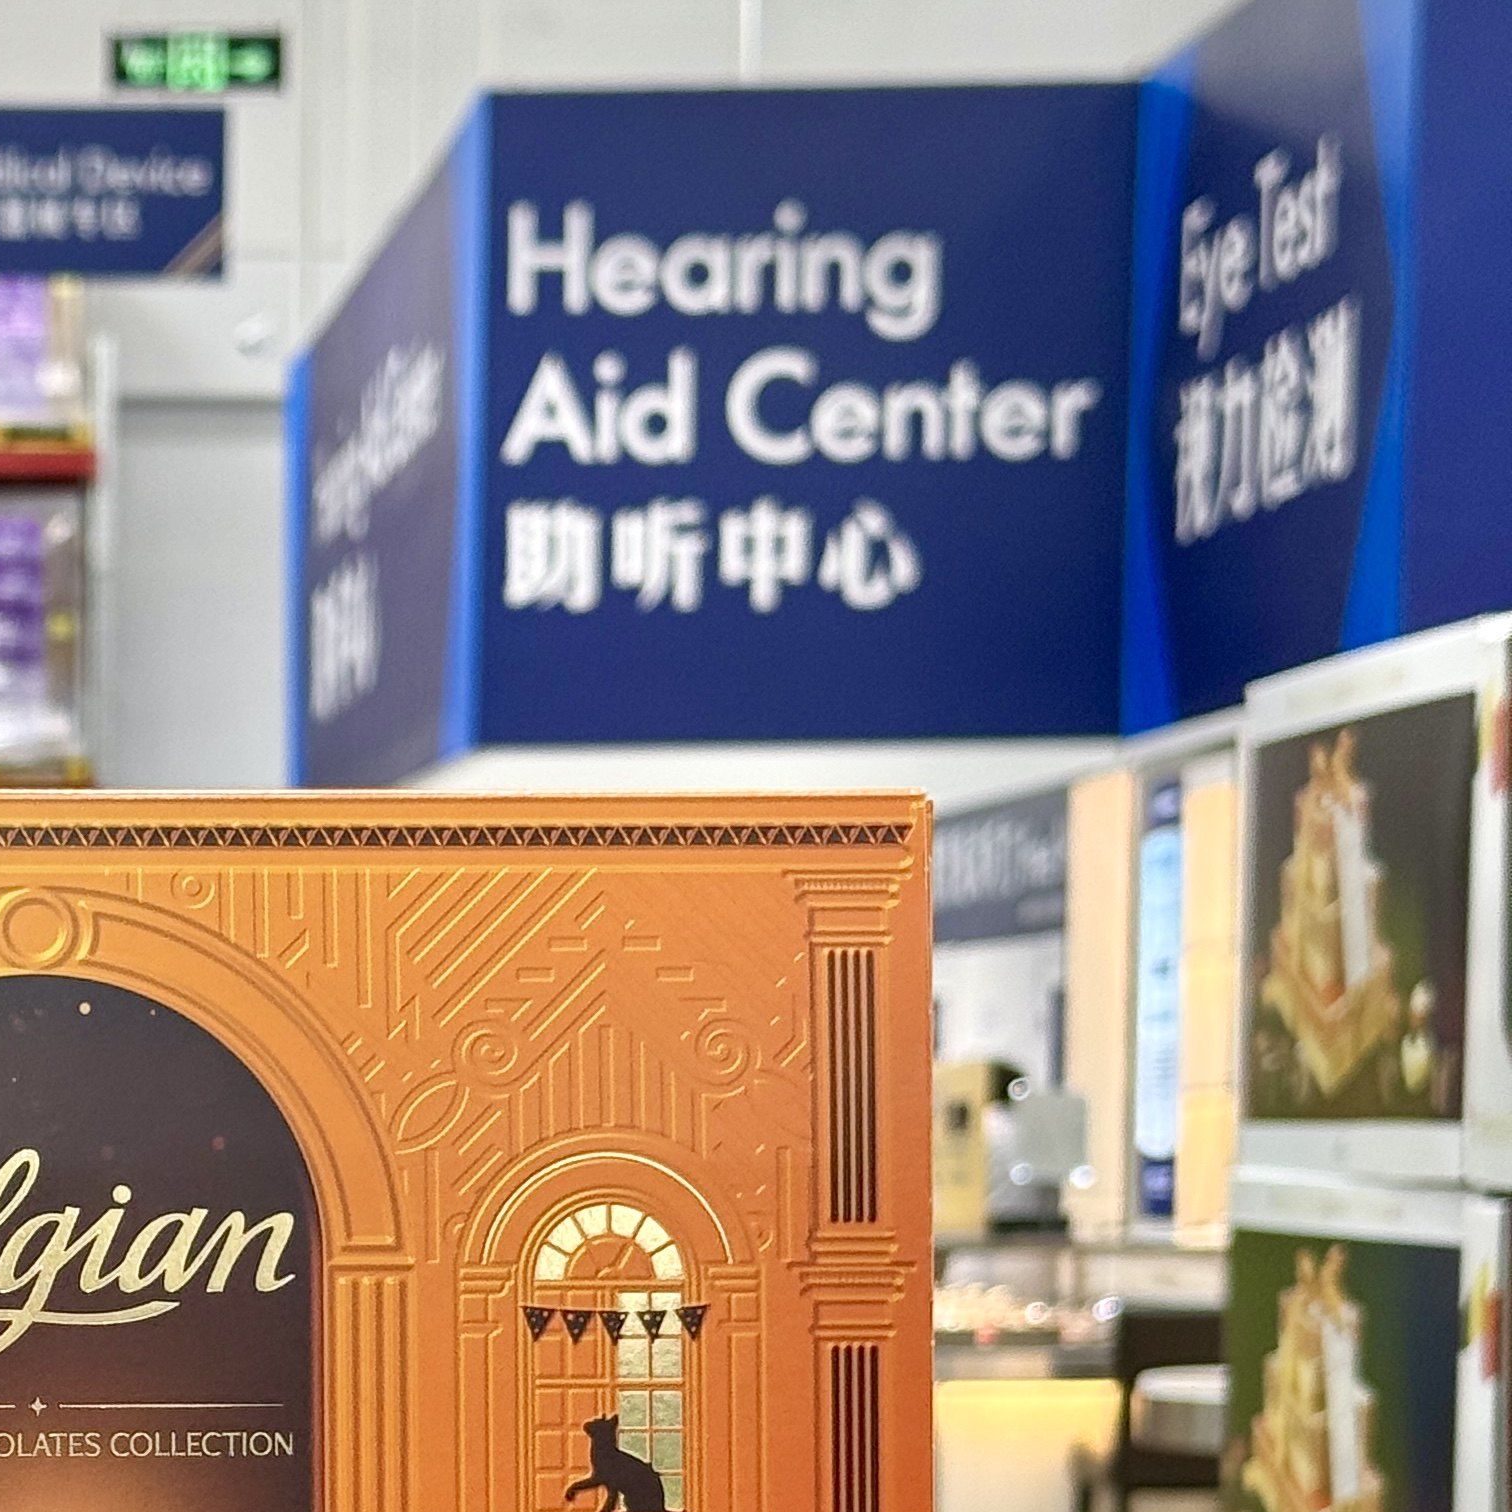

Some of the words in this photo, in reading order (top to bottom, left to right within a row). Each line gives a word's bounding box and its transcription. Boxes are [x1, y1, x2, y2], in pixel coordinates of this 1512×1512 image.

[507, 202, 939, 341] Hearing
[1179, 197, 1253, 362] Eye
[1254, 133, 1340, 287] Test
[501, 347, 698, 465] Aid
[725, 347, 1094, 465] Center
[503, 497, 922, 613] 助听中心
[110, 1430, 294, 1457] COLLECTION
